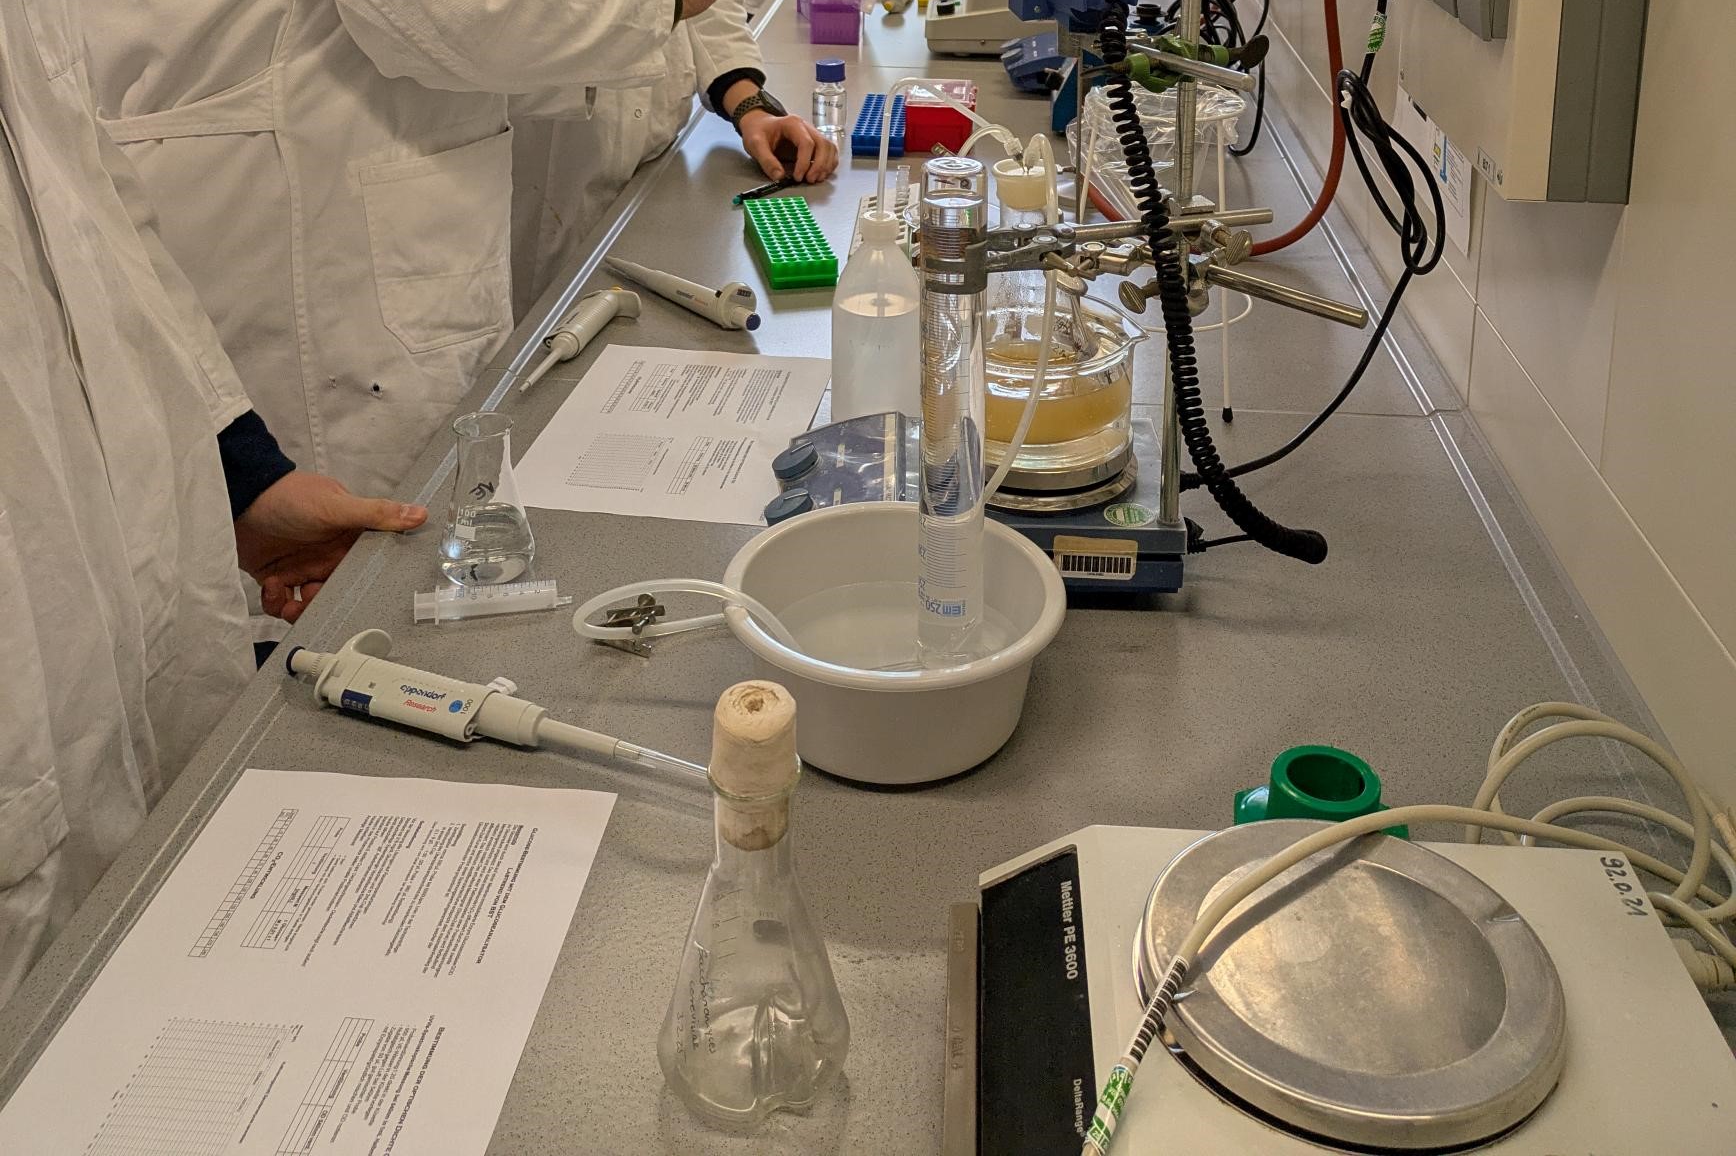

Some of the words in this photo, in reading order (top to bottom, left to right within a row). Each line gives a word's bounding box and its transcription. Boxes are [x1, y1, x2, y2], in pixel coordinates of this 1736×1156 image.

[1060, 880, 1075, 923] Mettler
[1063, 925, 1077, 944] PE
[1064, 945, 1079, 980] 3600
